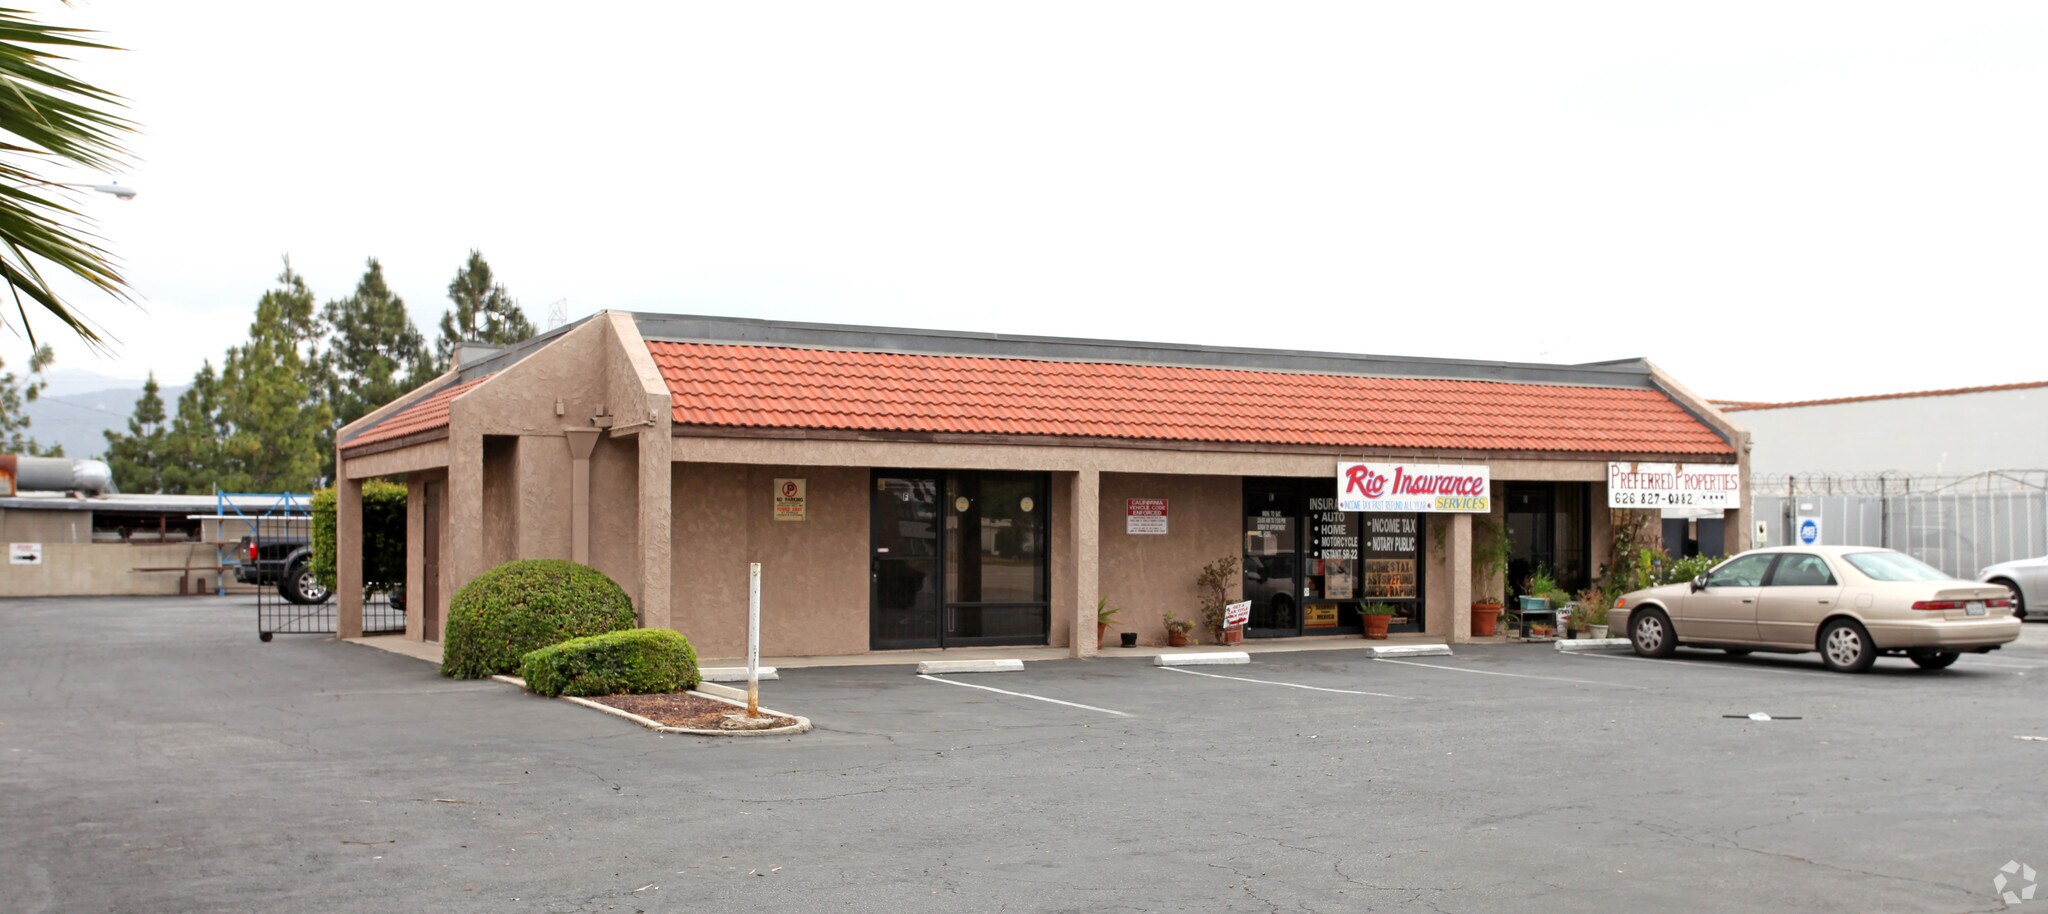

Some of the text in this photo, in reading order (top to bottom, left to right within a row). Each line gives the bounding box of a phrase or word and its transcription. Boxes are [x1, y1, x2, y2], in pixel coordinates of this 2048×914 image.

[1345, 465, 1485, 499] Rio Insurance
[1611, 464, 1738, 490] PREFERRED PROPERTIES
[1309, 498, 1339, 510] INSURA
[1437, 497, 1485, 509] SERVICES
[1615, 492, 1635, 504] 626
[1344, 500, 1427, 510] INCOME TAX FAST REFUND ALL YEAR
[1321, 512, 1345, 522] AUTO
[1321, 524, 1346, 535] HOME
[1372, 518, 1416, 533] INCOME TAX
[1321, 536, 1358, 547] MOTORCYCLE
[1373, 537, 1415, 552] NOTARY PUBLIC
[1321, 549, 1358, 559] INSTANT SR-22
